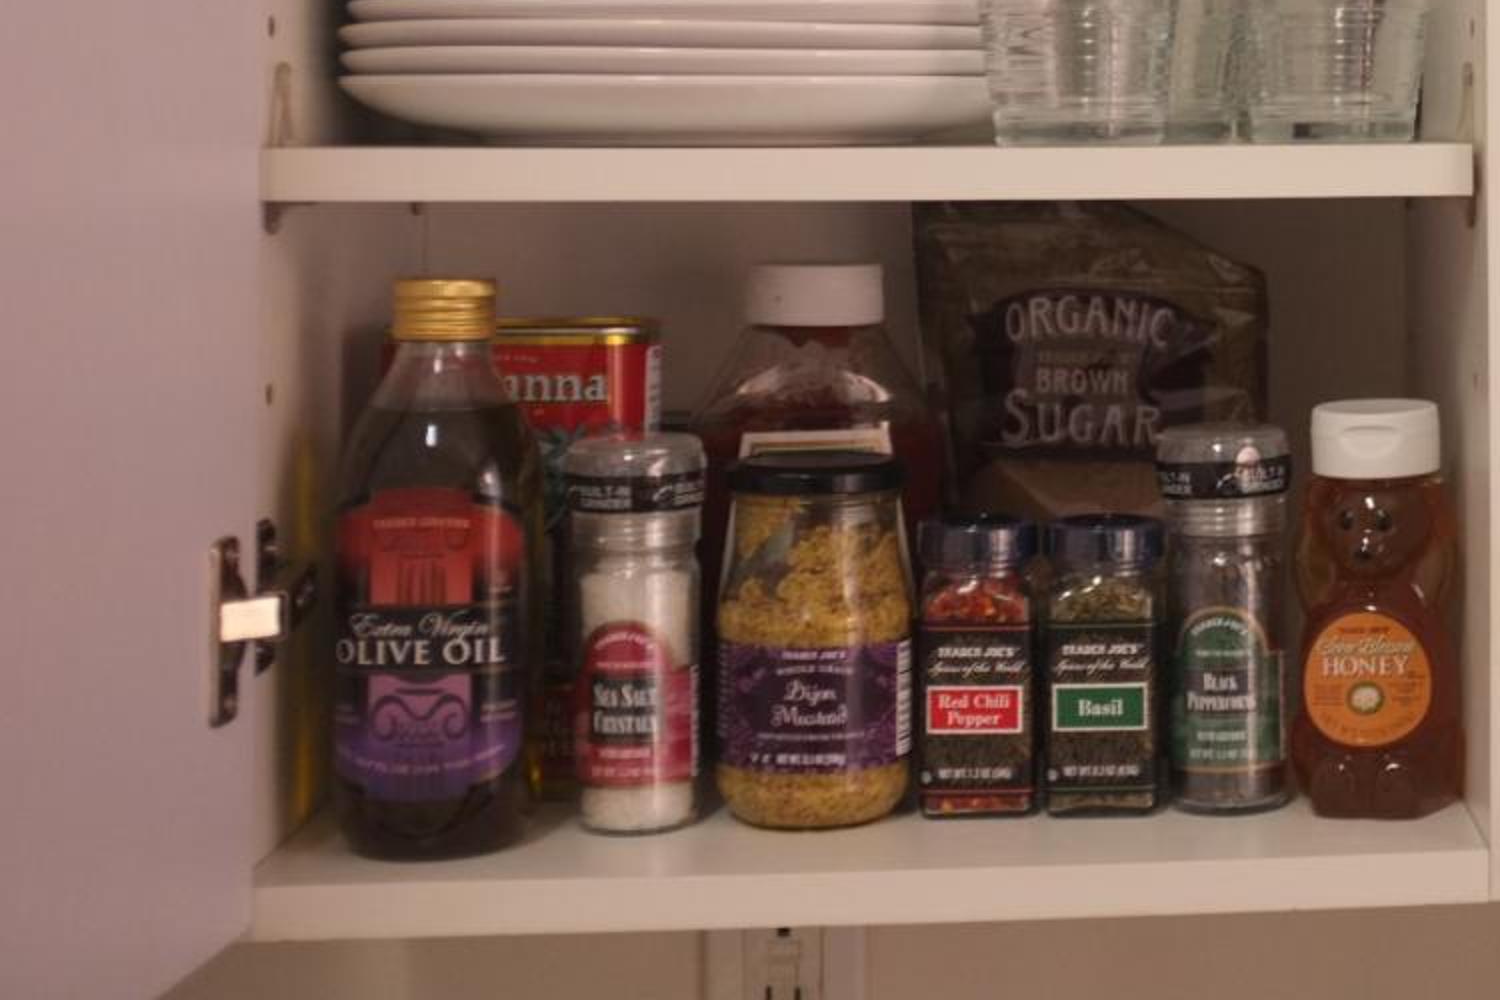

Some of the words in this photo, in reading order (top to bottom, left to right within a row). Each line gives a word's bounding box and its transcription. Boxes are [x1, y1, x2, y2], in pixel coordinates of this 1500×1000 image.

[1005, 296, 1175, 347] ORGANIC
[1036, 368, 1128, 394] BROWN
[1002, 388, 1160, 446] SUGAR
[351, 612, 412, 638] Extra
[418, 610, 489, 645] Virgin
[336, 639, 430, 666] OLIVE
[443, 637, 507, 665] OIL
[1322, 655, 1409, 677] HONEY
[938, 694, 969, 708] Red
[973, 694, 1010, 709] Chili
[1078, 698, 1123, 717] Basil
[947, 711, 1001, 728] Pepper
